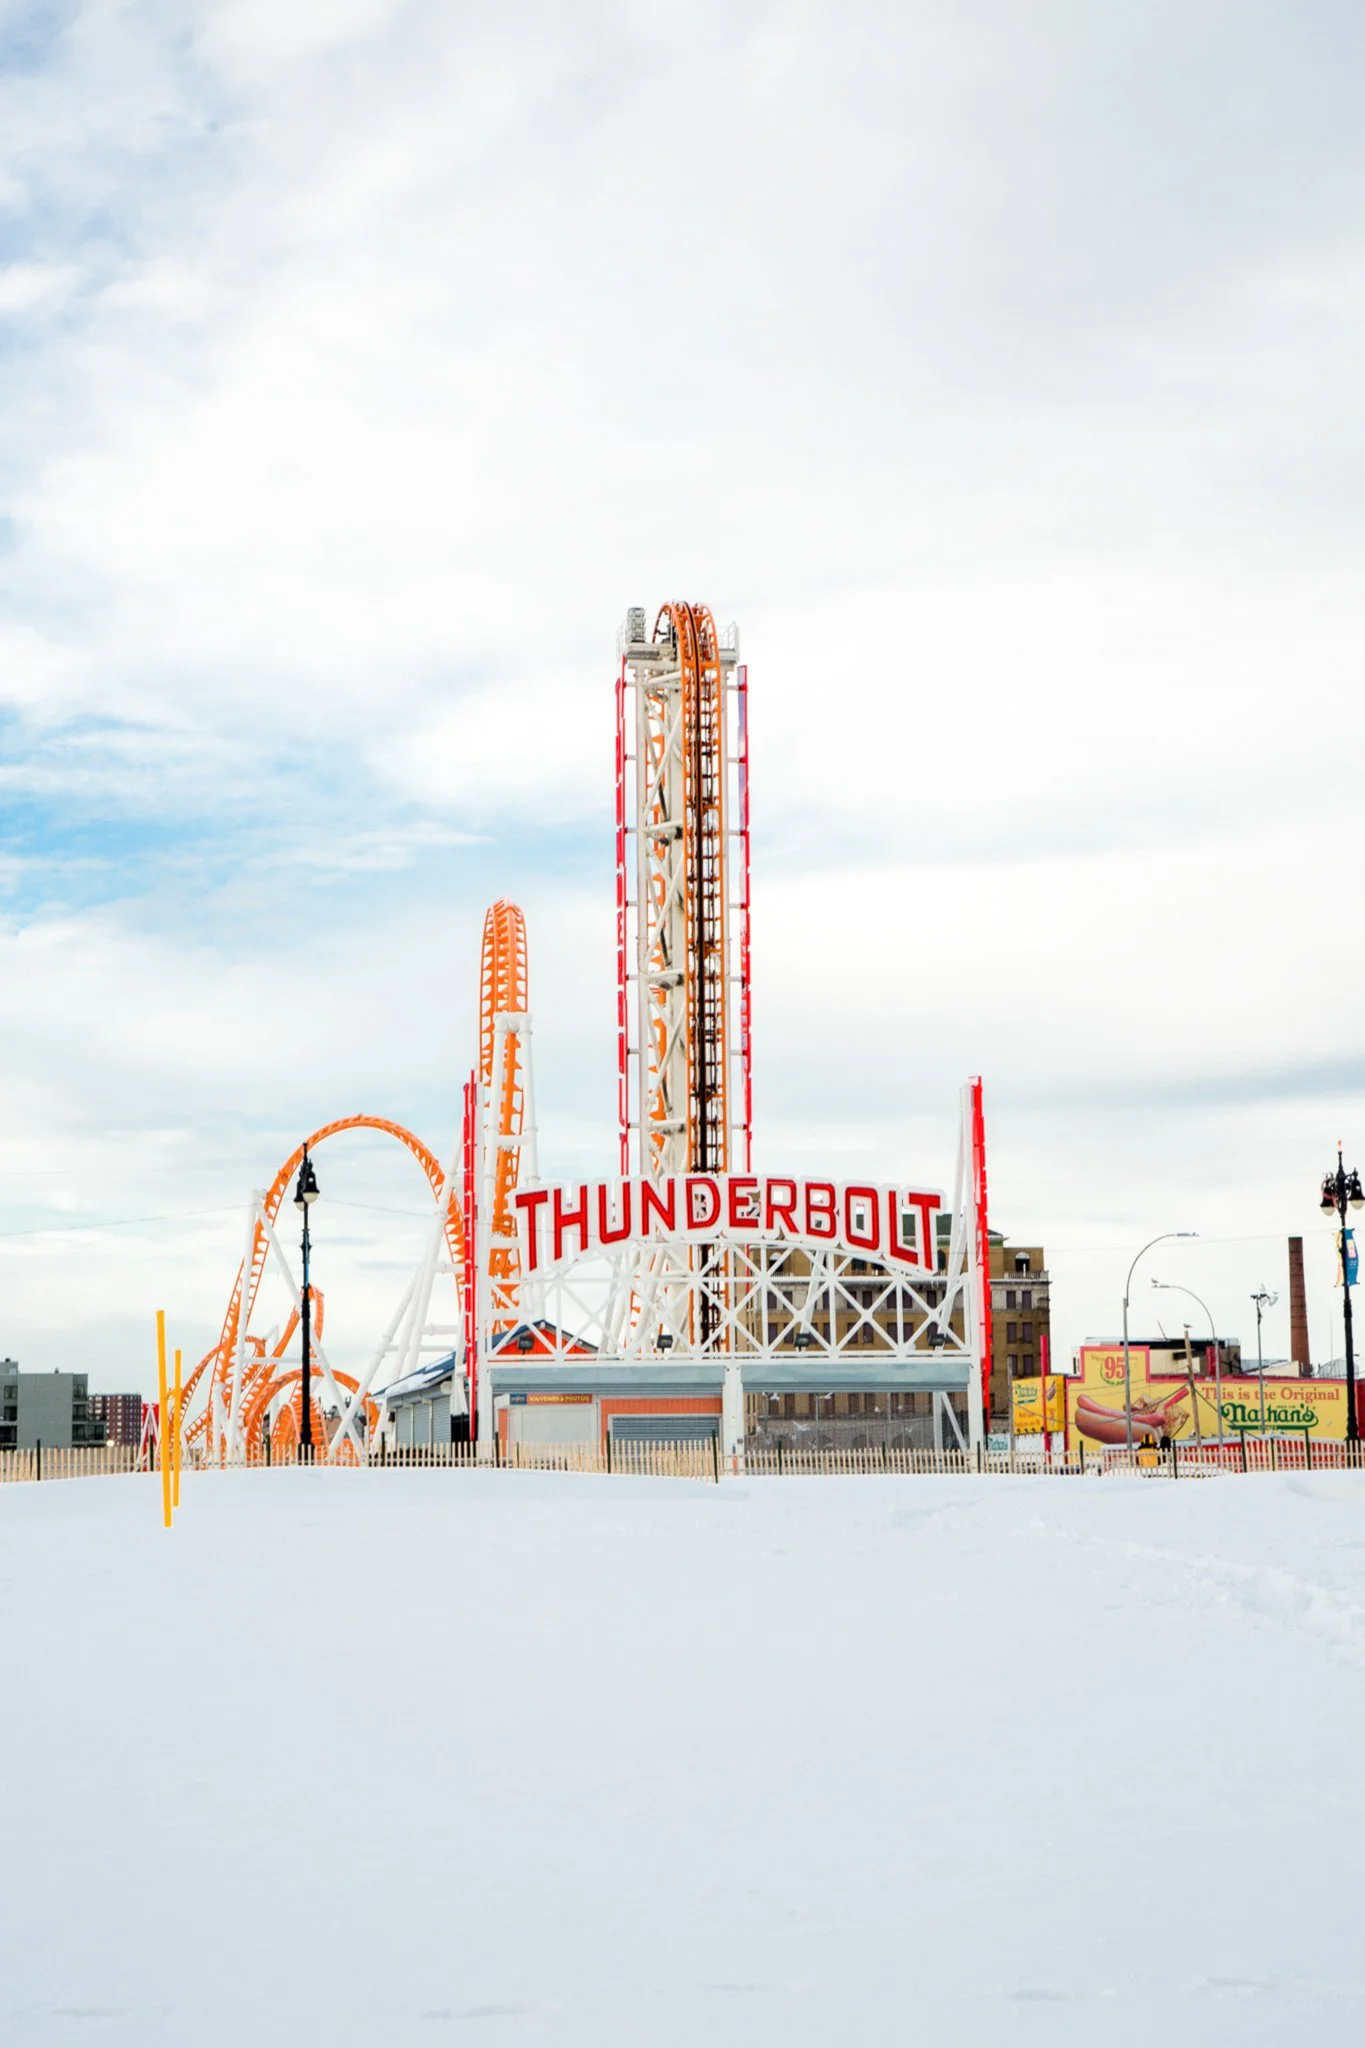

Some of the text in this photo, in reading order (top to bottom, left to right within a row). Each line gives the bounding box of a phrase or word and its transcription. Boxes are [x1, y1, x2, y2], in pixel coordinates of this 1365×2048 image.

[515, 1177, 942, 1271] THUNDERBOLT
[1103, 1356, 1127, 1379] 95
[1238, 1387, 1250, 1400] is
[1280, 1387, 1340, 1404] Original
[1220, 1402, 1317, 1427] Nahan's
